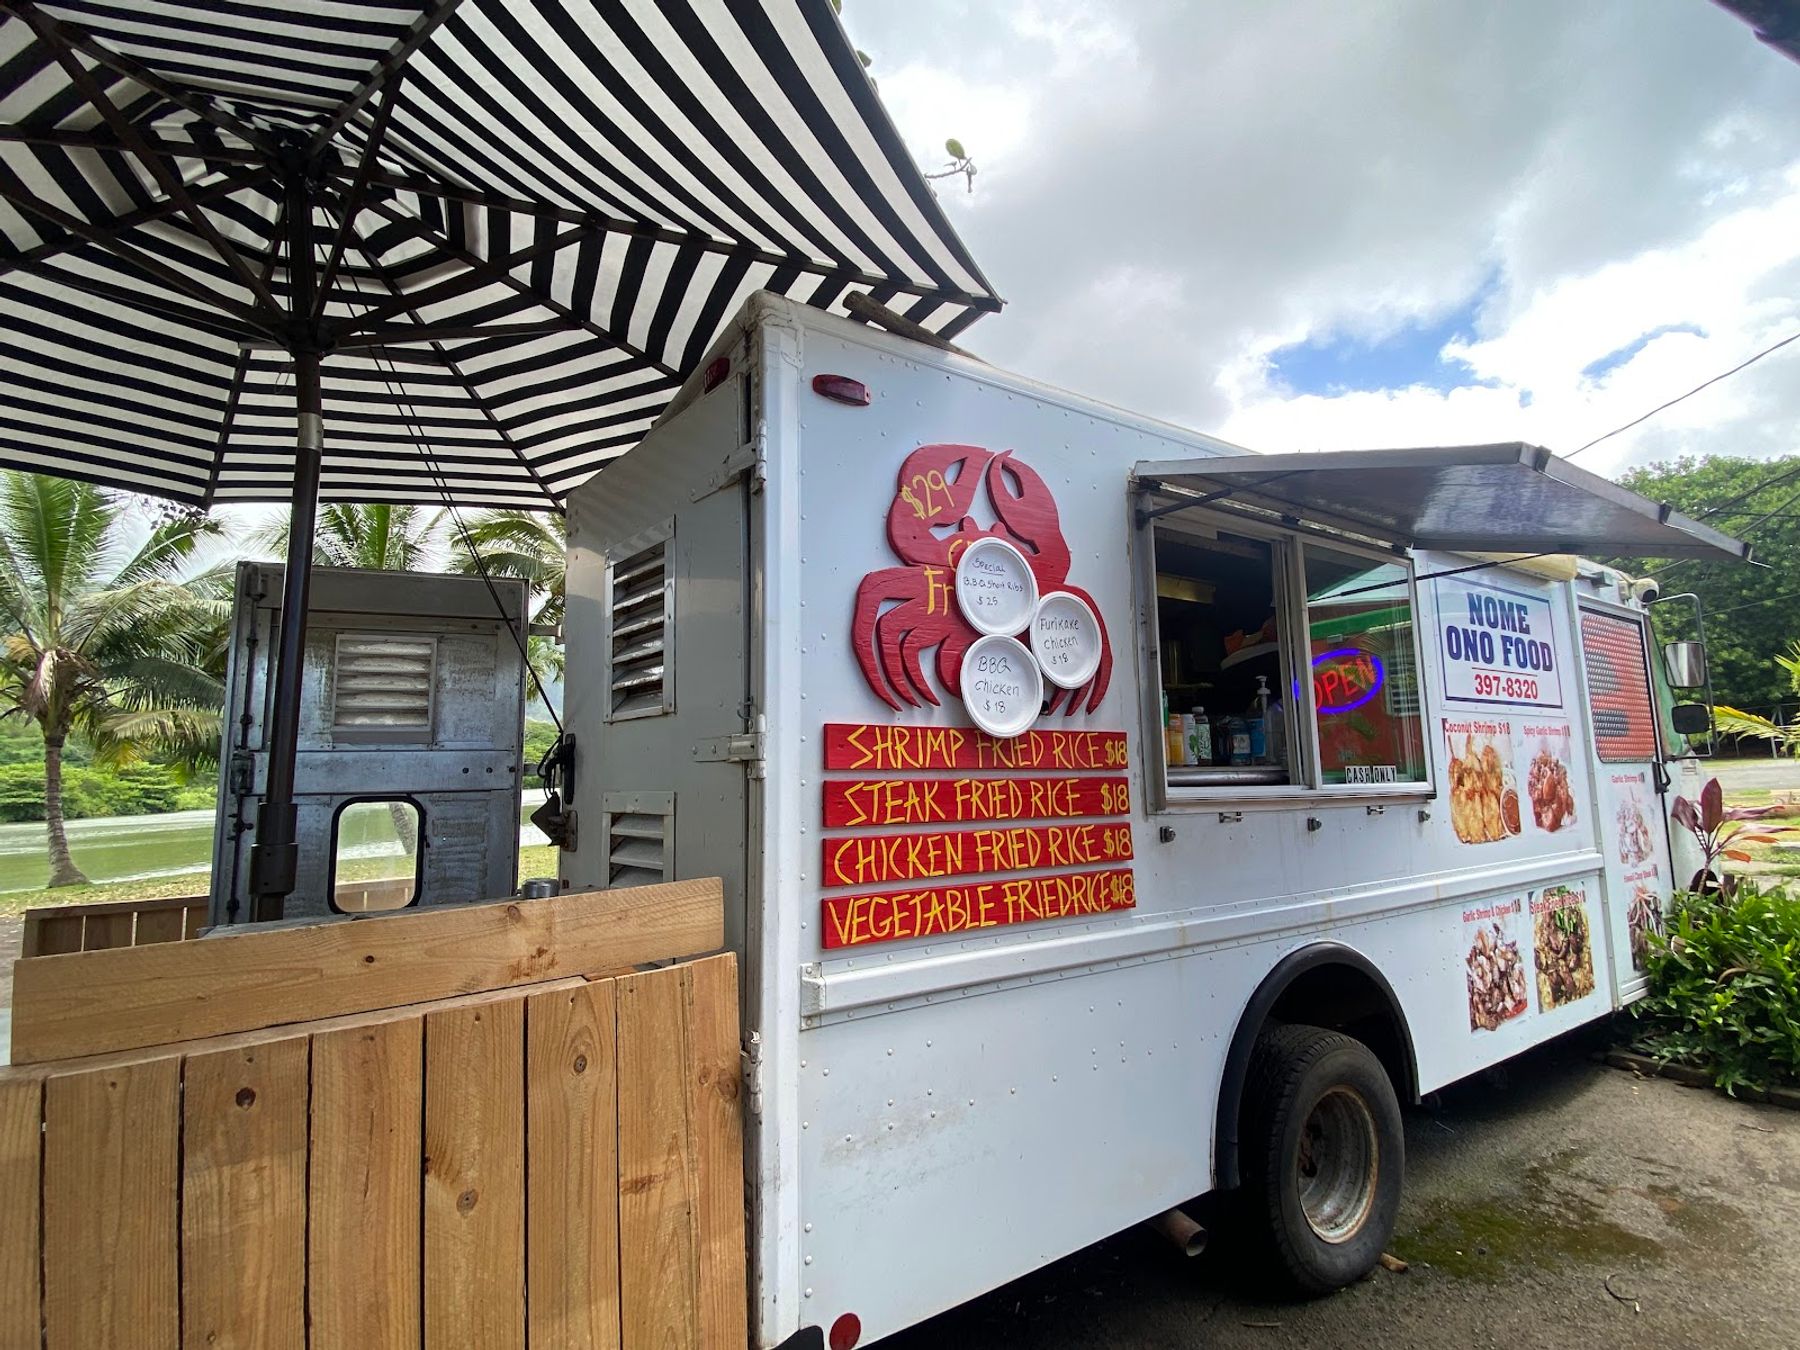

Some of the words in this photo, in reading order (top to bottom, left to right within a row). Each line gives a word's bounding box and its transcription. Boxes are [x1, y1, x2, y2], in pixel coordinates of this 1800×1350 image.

[901, 470, 955, 520] $29
[1467, 592, 1531, 635] NOME
[978, 655, 1012, 674] BBQ
[1446, 625, 1495, 665] ONO
[1500, 634, 1553, 672] FOOD
[1474, 673, 1538, 700] 397-8320
[847, 725, 965, 769] SHRIMP
[975, 730, 1044, 769] FRIED
[1052, 732, 1104, 769] RICE
[1104, 738, 1128, 766] $18
[1473, 720, 1497, 737] Shrimp
[1346, 767, 1371, 783] CASH
[1373, 767, 1396, 783] ONLY
[843, 780, 946, 827] STEAK
[954, 778, 1023, 821] FRIED
[1029, 778, 1084, 818] RICE
[1100, 782, 1130, 816] $18
[834, 832, 962, 884] CHICKEN
[974, 828, 1042, 873] FRIED
[1048, 824, 1102, 867] RICE
[1103, 828, 1133, 858] $18
[828, 885, 998, 945] VEGETABLE
